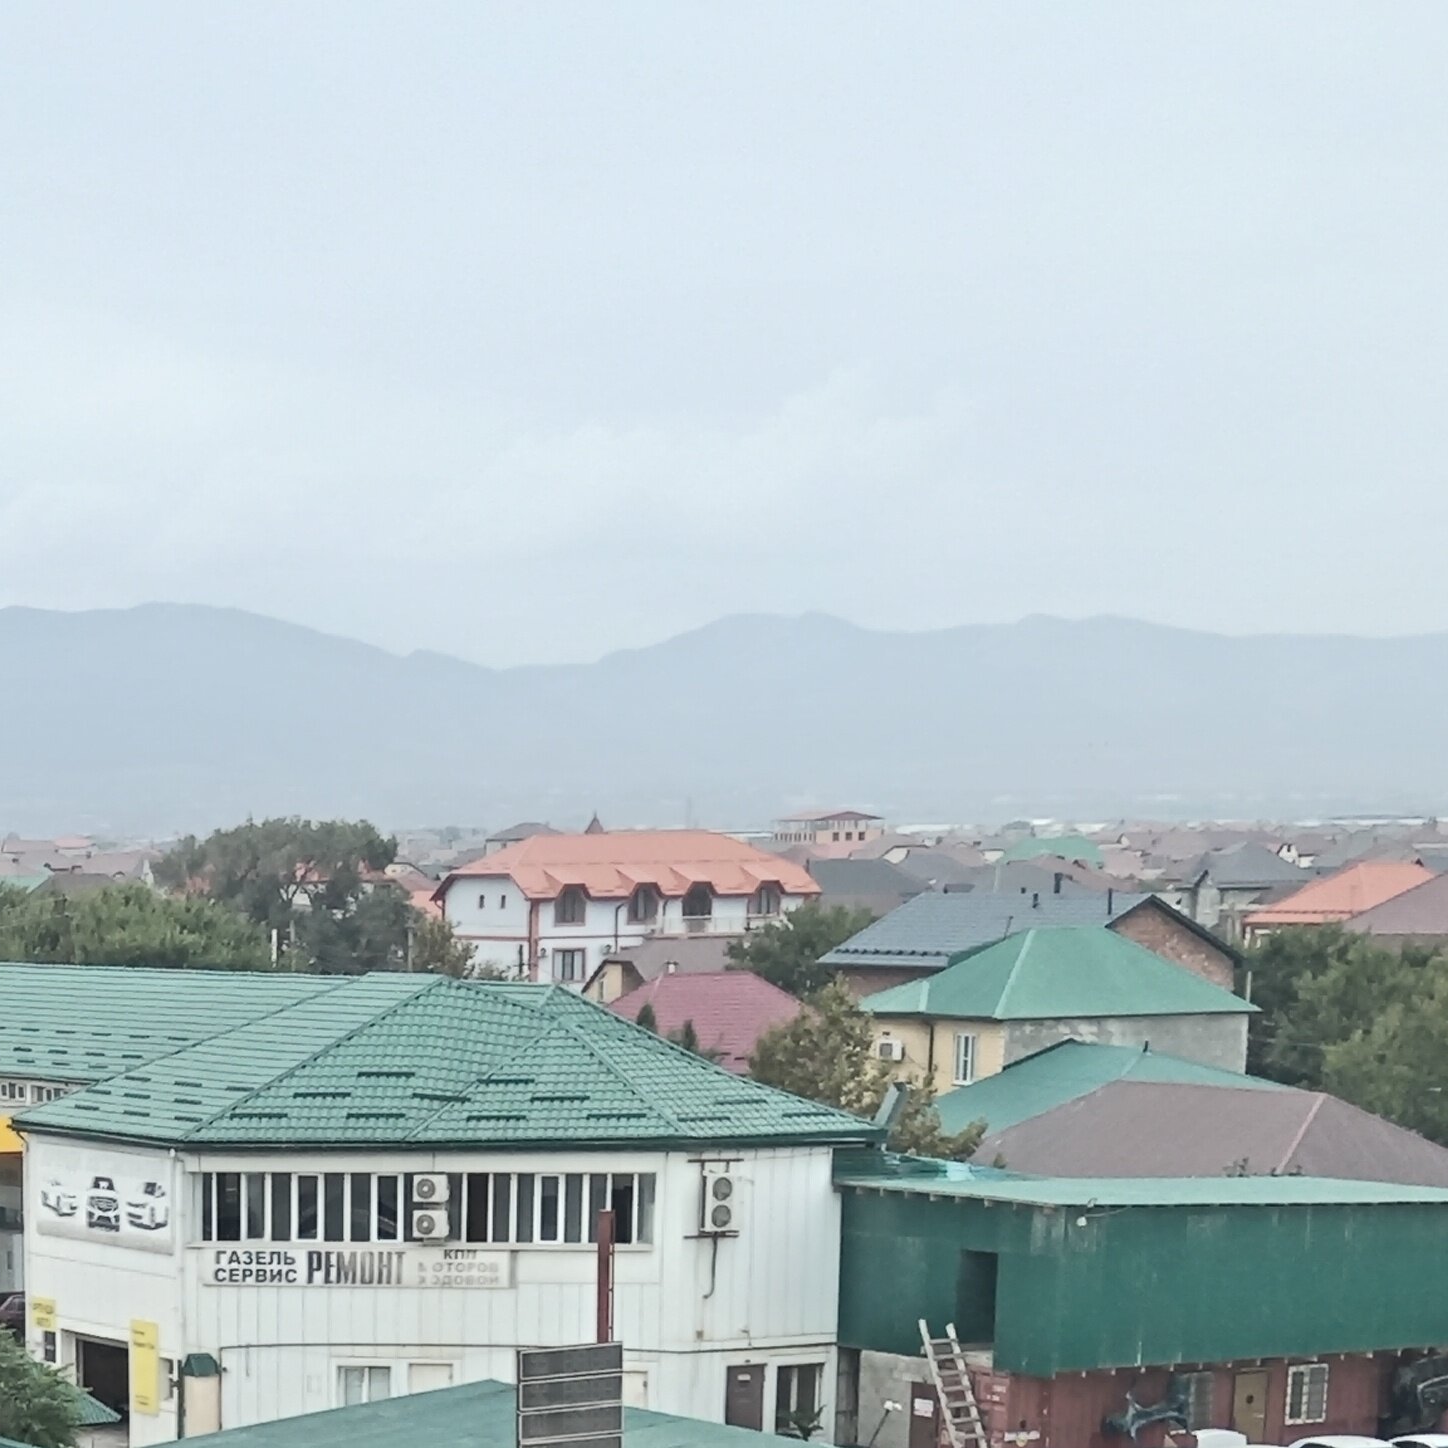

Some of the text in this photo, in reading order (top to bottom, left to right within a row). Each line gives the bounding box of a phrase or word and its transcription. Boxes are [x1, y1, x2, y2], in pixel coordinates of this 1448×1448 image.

[214, 1250, 296, 1265] ГАЗЕЛЬ
[307, 1250, 406, 1285] РЕМОНТ
[214, 1268, 298, 1284] СЕРВИС
